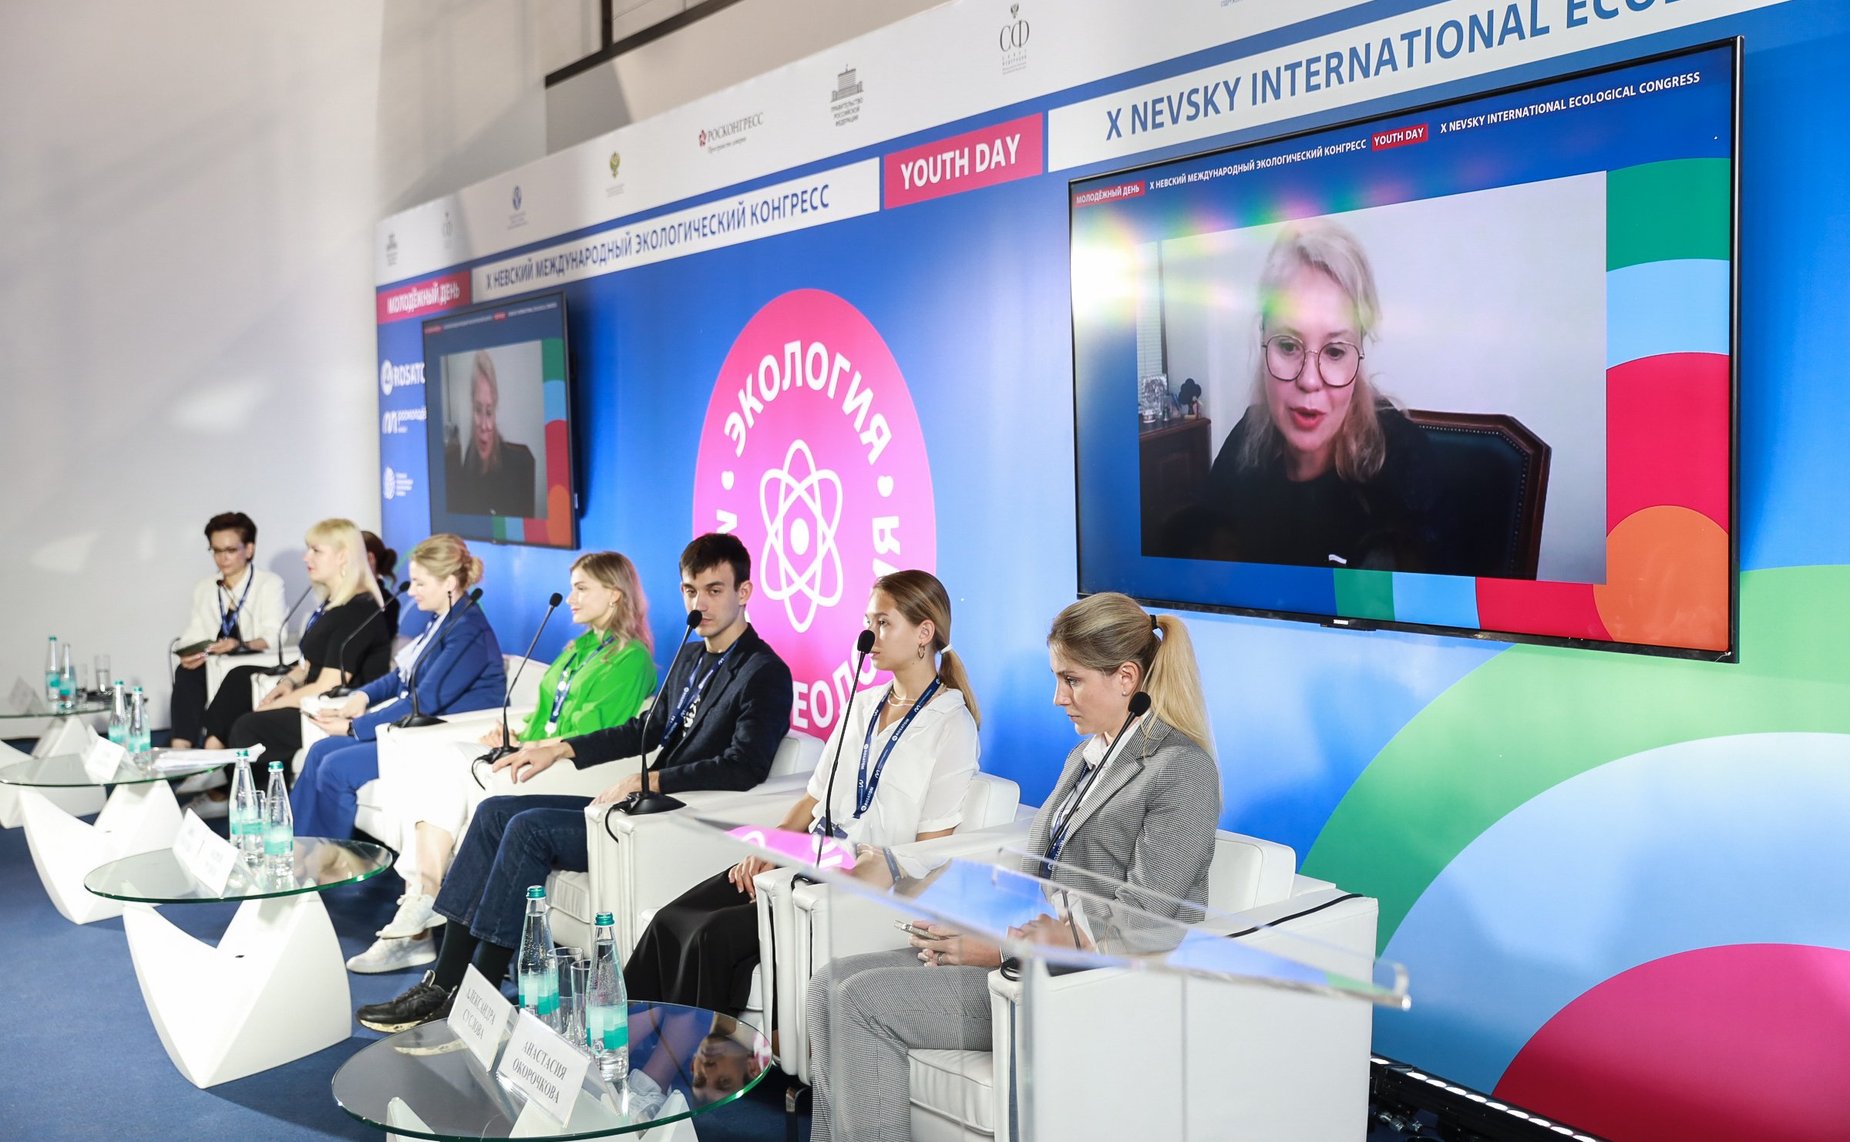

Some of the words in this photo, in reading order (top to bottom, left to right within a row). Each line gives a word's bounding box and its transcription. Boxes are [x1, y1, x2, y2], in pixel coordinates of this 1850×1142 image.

[1131, 76, 1242, 135] NEVSKY
[1251, 0, 1550, 106] INTERNATIONAL
[1449, 115, 1485, 132] NEVSKY
[1487, 100, 1567, 124] INTERNATIONAL
[1569, 85, 1637, 108] ECOLOGICAL
[1639, 71, 1700, 94] CONGRESS
[901, 147, 969, 190] YOUTH
[975, 133, 1021, 173] DAY
[1374, 131, 1404, 147] YOUTH
[1405, 127, 1424, 141] DAY
[1123, 184, 1140, 197] ДЕНЬ
[1155, 173, 1187, 189] НЕВСКИЙ
[1187, 159, 1255, 183] МЕЖДУНАРОДНЫЙ
[1256, 146, 1323, 170] ЭКОЛОГИЧЕСКИЙ
[1324, 139, 1367, 157] КОНГРЕСС
[493, 260, 535, 288] НЕВСКИЙ
[536, 232, 633, 278] МЕЖДУНАРОДНЫЙ
[635, 201, 747, 254] ЭКОЛОГИЧЕСКИЙ
[750, 184, 830, 227] КОНГРЕСС
[723, 340, 893, 466] ЭКОЛОГИЯ
[512, 1057, 560, 1104] ОКОРОЧКОВА
[523, 1040, 568, 1081] АНАСТАСИЯ
